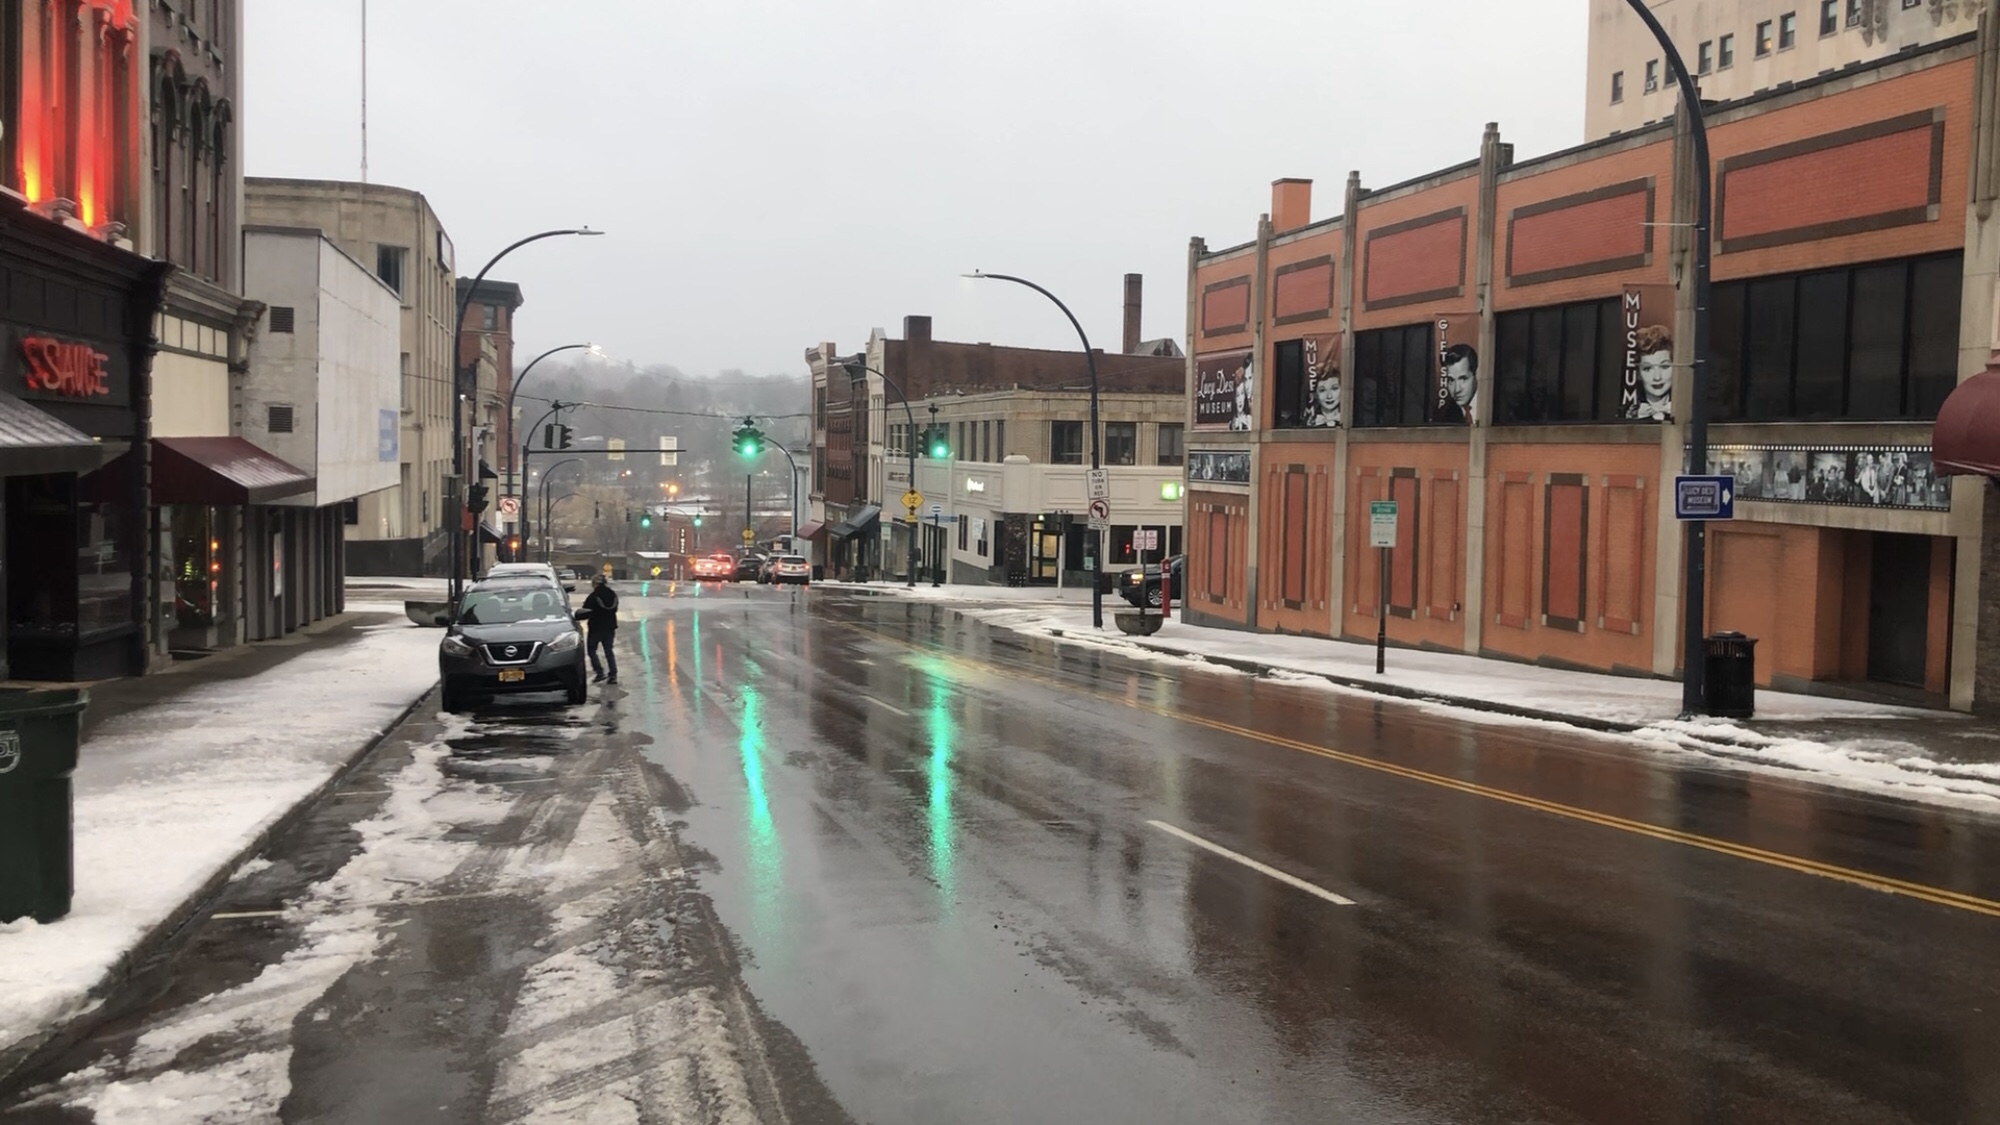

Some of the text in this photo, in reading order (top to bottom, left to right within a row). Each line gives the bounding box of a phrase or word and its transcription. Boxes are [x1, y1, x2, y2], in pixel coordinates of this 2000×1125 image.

[1438, 319, 1448, 409] GIFT SHOP
[1622, 292, 1640, 405] MUSEUM
[1198, 369, 1234, 400] Lucy Desi
[1200, 401, 1232, 414] MUSEUM
